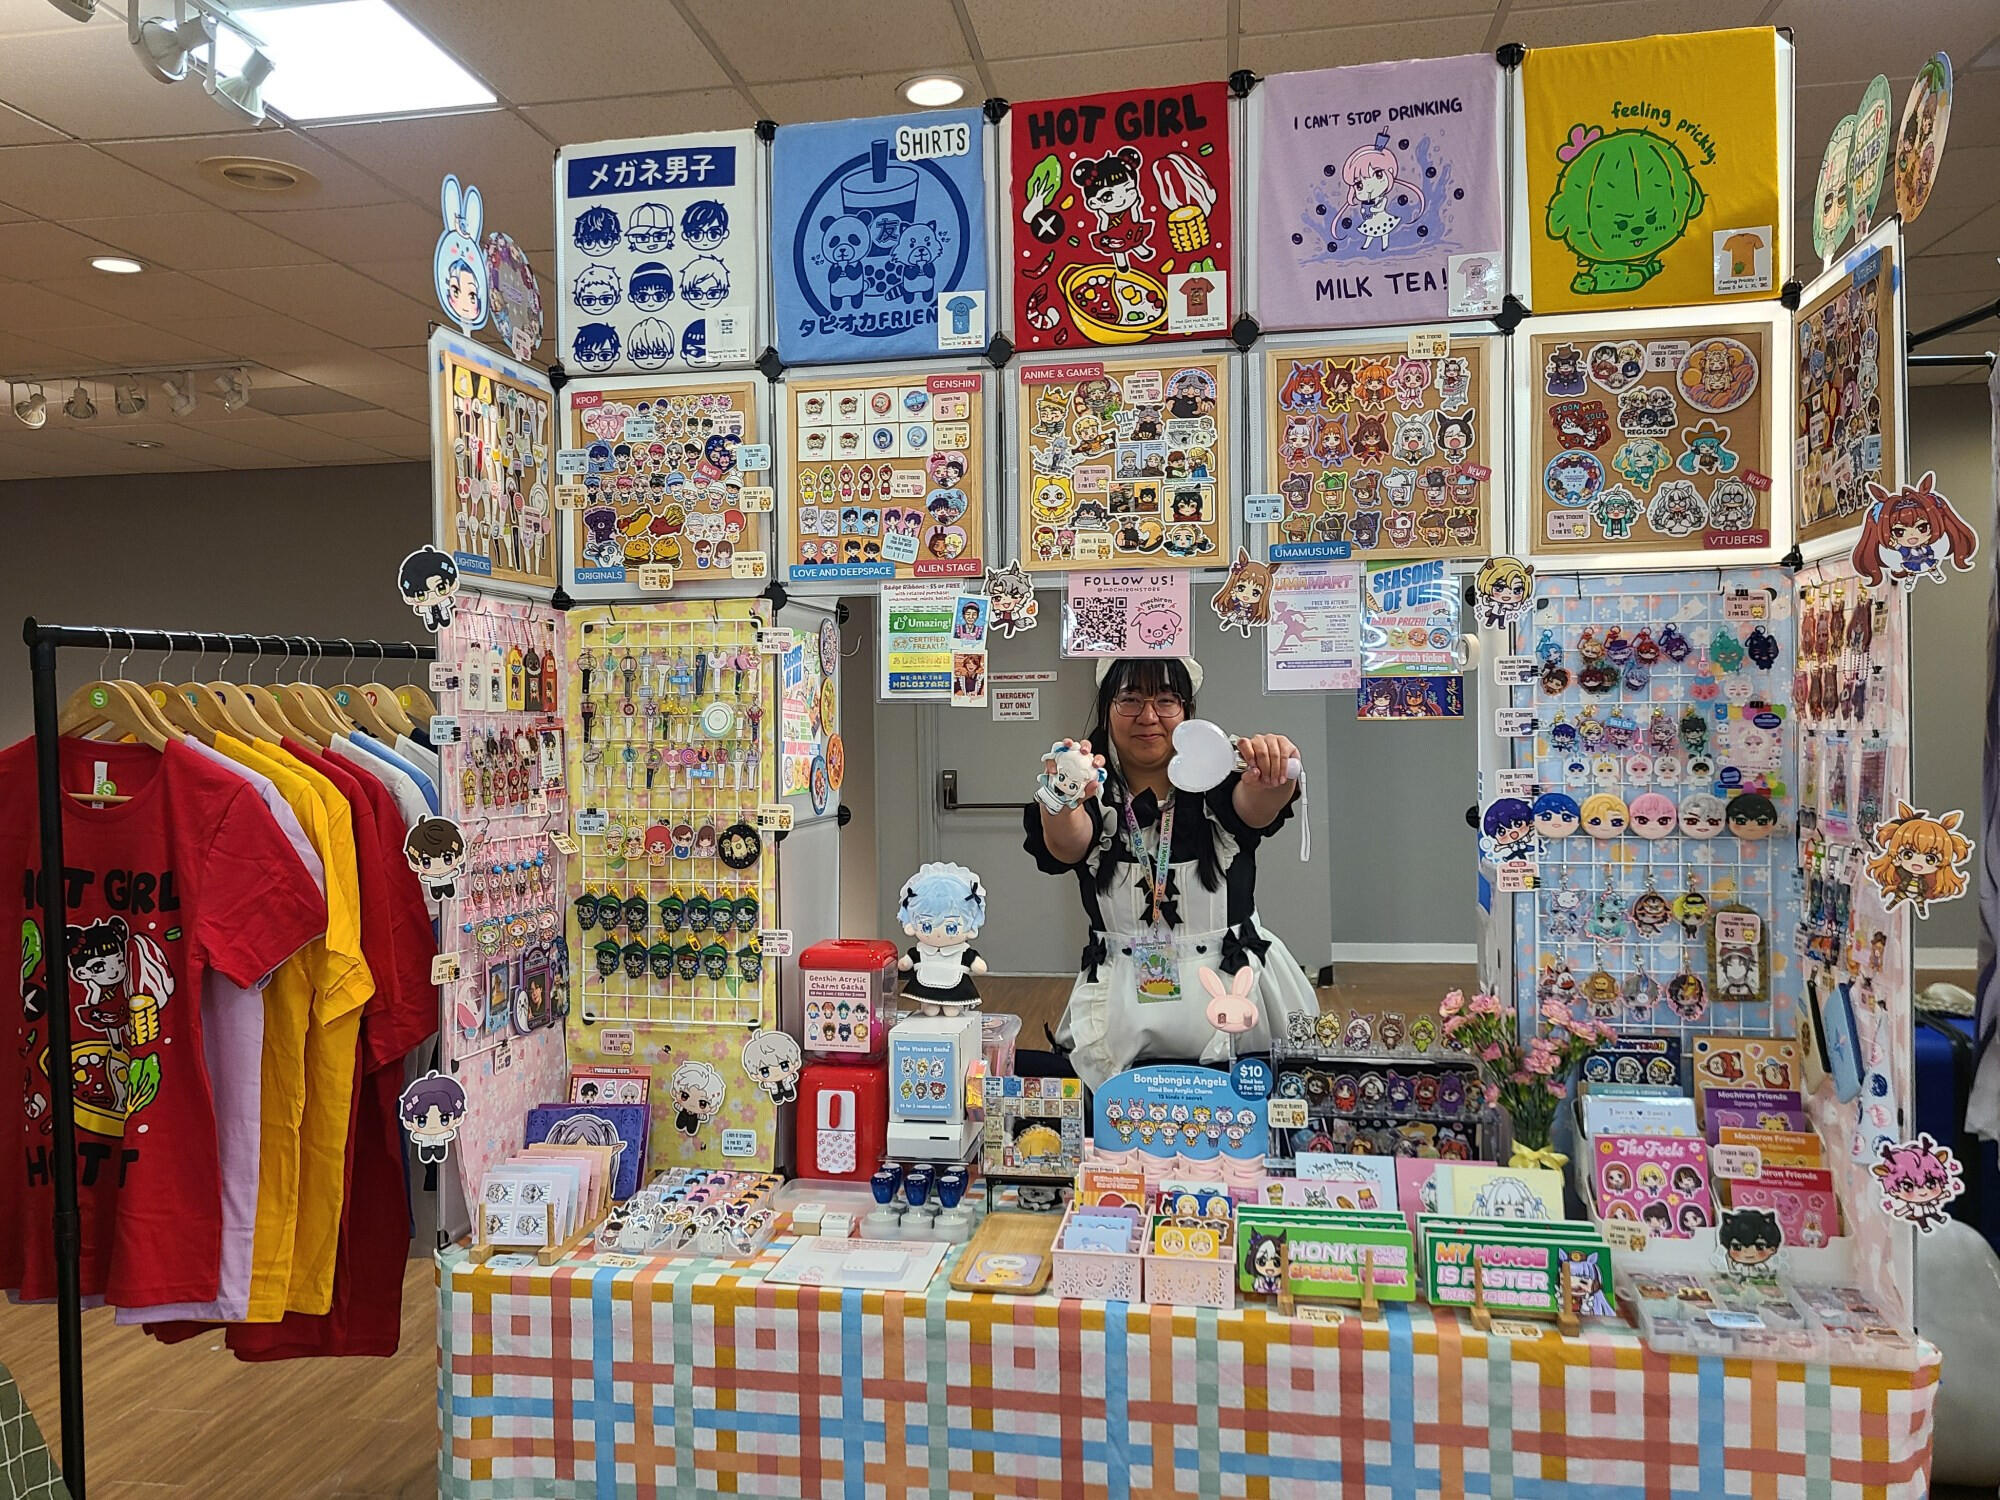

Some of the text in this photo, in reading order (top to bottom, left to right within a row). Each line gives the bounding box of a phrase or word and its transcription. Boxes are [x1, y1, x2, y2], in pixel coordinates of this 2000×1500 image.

[1294, 97, 1462, 130] I CAN'T STOP DRINKING
[1029, 94, 1208, 149] HOT GIRL
[1611, 100, 1716, 166] feeling prickly.
[900, 128, 966, 157] SHIRTS
[588, 154, 715, 190] メガネ男子
[876, 218, 900, 243] 友
[1316, 267, 1447, 301] MILK TEA!
[1655, 357, 1666, 367] $8
[1024, 368, 1100, 379] ANIME & GAMES
[933, 380, 975, 389] GENSHIN
[576, 395, 599, 406] KPOP
[1582, 404, 1595, 412] MY
[1114, 410, 1140, 424] DILF
[1585, 412, 1607, 420] SOUL
[745, 459, 752, 467] $3
[1467, 465, 1487, 479] NEW!!
[1709, 534, 1763, 546] VTUBERS
[1275, 546, 1346, 557] UMAMUSUME
[455, 557, 490, 571] LIGHTSTICKS
[917, 563, 976, 572] ALIEN STAGE
[577, 570, 623, 582] ORIGINALS
[792, 566, 892, 577] LOVE AND DEEPSPACE
[1373, 561, 1444, 594] SEASONS
[1084, 575, 1174, 586] FOLLOW US!
[1140, 597, 1173, 607] mochiron
[1383, 590, 1402, 611] OF
[908, 618, 951, 631] Umazing!
[1423, 652, 1446, 662] ticket
[94, 692, 104, 705] S
[336, 692, 348, 705] XL
[103, 784, 112, 796] S
[1724, 928, 1734, 938] $5
[1240, 1065, 1263, 1078] $10
[1133, 1074, 1227, 1087] Bongbongie Angels
[1718, 1091, 1788, 1101] Mochiron Friends
[1734, 1132, 1806, 1145] Mochiron Friends
[1616, 1138, 1685, 1158] The Feels
[26, 1143, 111, 1188] HT
[1761, 1169, 1818, 1180] hiron Friends
[1290, 1243, 1356, 1264] HONK
[1436, 1242, 1549, 1267] MY HORSE
[1437, 1265, 1550, 1290] IS FASTER
